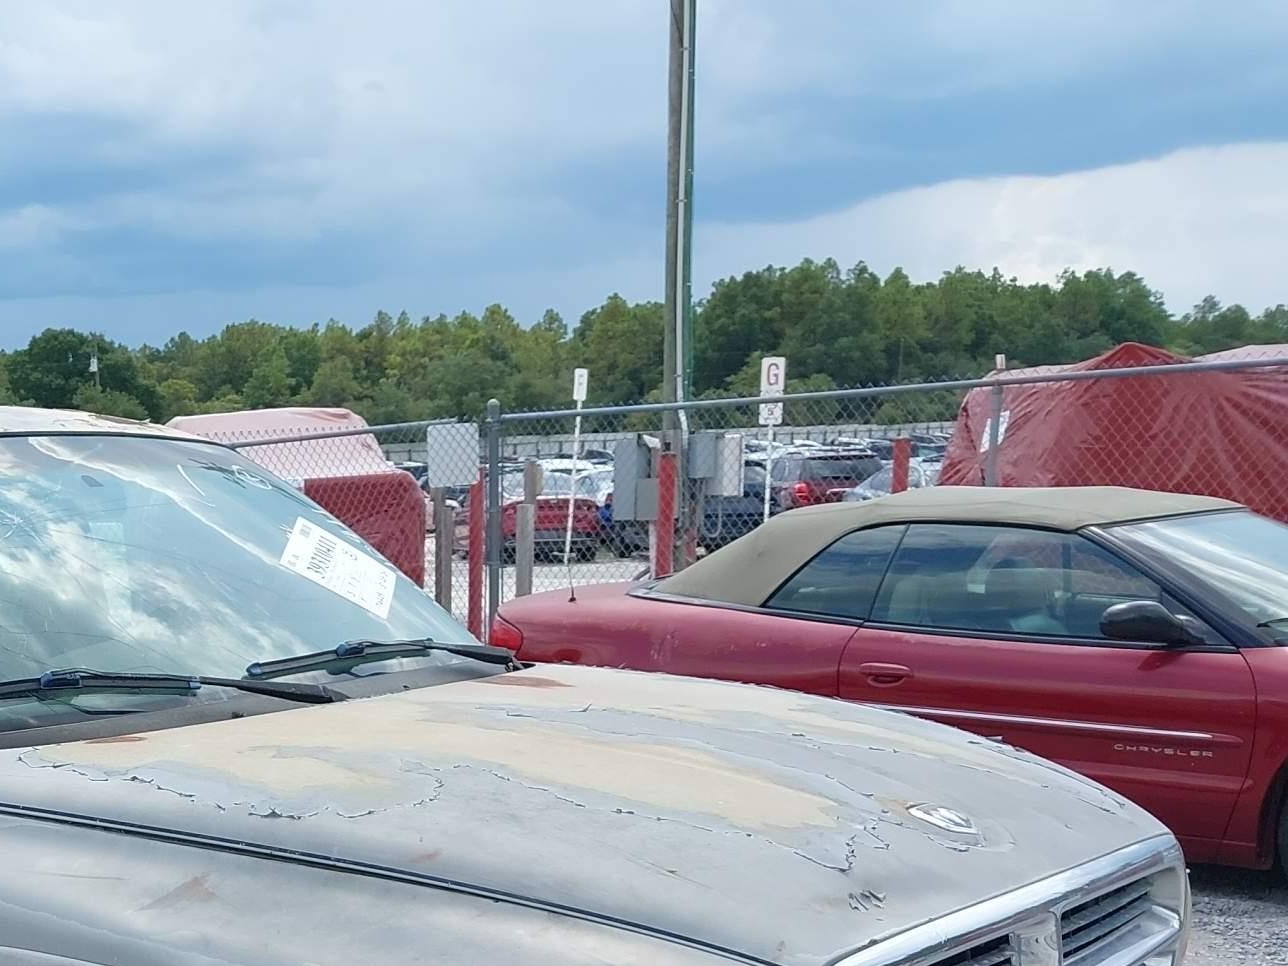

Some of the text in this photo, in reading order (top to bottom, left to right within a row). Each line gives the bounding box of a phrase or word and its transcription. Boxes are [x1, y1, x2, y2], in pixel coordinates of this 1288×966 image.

[767, 362, 780, 387] G
[306, 535, 337, 580] 39310411
[1113, 744, 1213, 757] CHRYSLER
